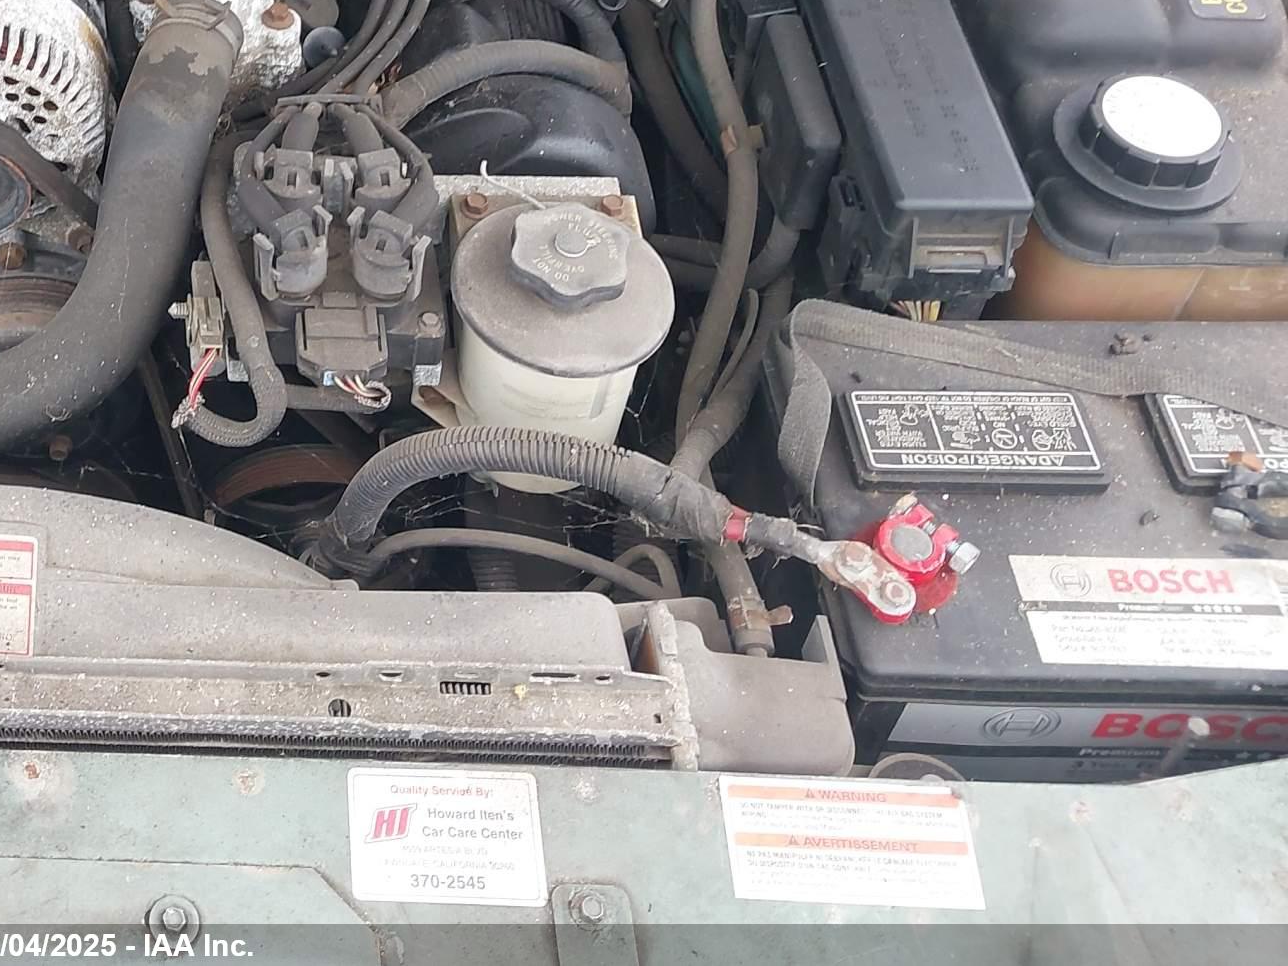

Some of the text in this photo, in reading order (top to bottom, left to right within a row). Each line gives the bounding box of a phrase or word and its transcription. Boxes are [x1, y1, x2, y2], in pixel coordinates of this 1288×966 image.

[533, 258, 551, 277] NOT
[901, 453, 1050, 466] DANGER/POISON
[1107, 569, 1236, 594] BOSCH
[1078, 747, 1161, 757] Premium
[390, 785, 494, 798] Quality Service By:
[819, 789, 887, 803] WARNING
[428, 808, 515, 821] Howard Iten's
[372, 807, 409, 839] HI
[422, 827, 523, 840] Car Care Center
[803, 836, 919, 852] AVERTISSEMENT
[410, 874, 486, 890] 370-2545
